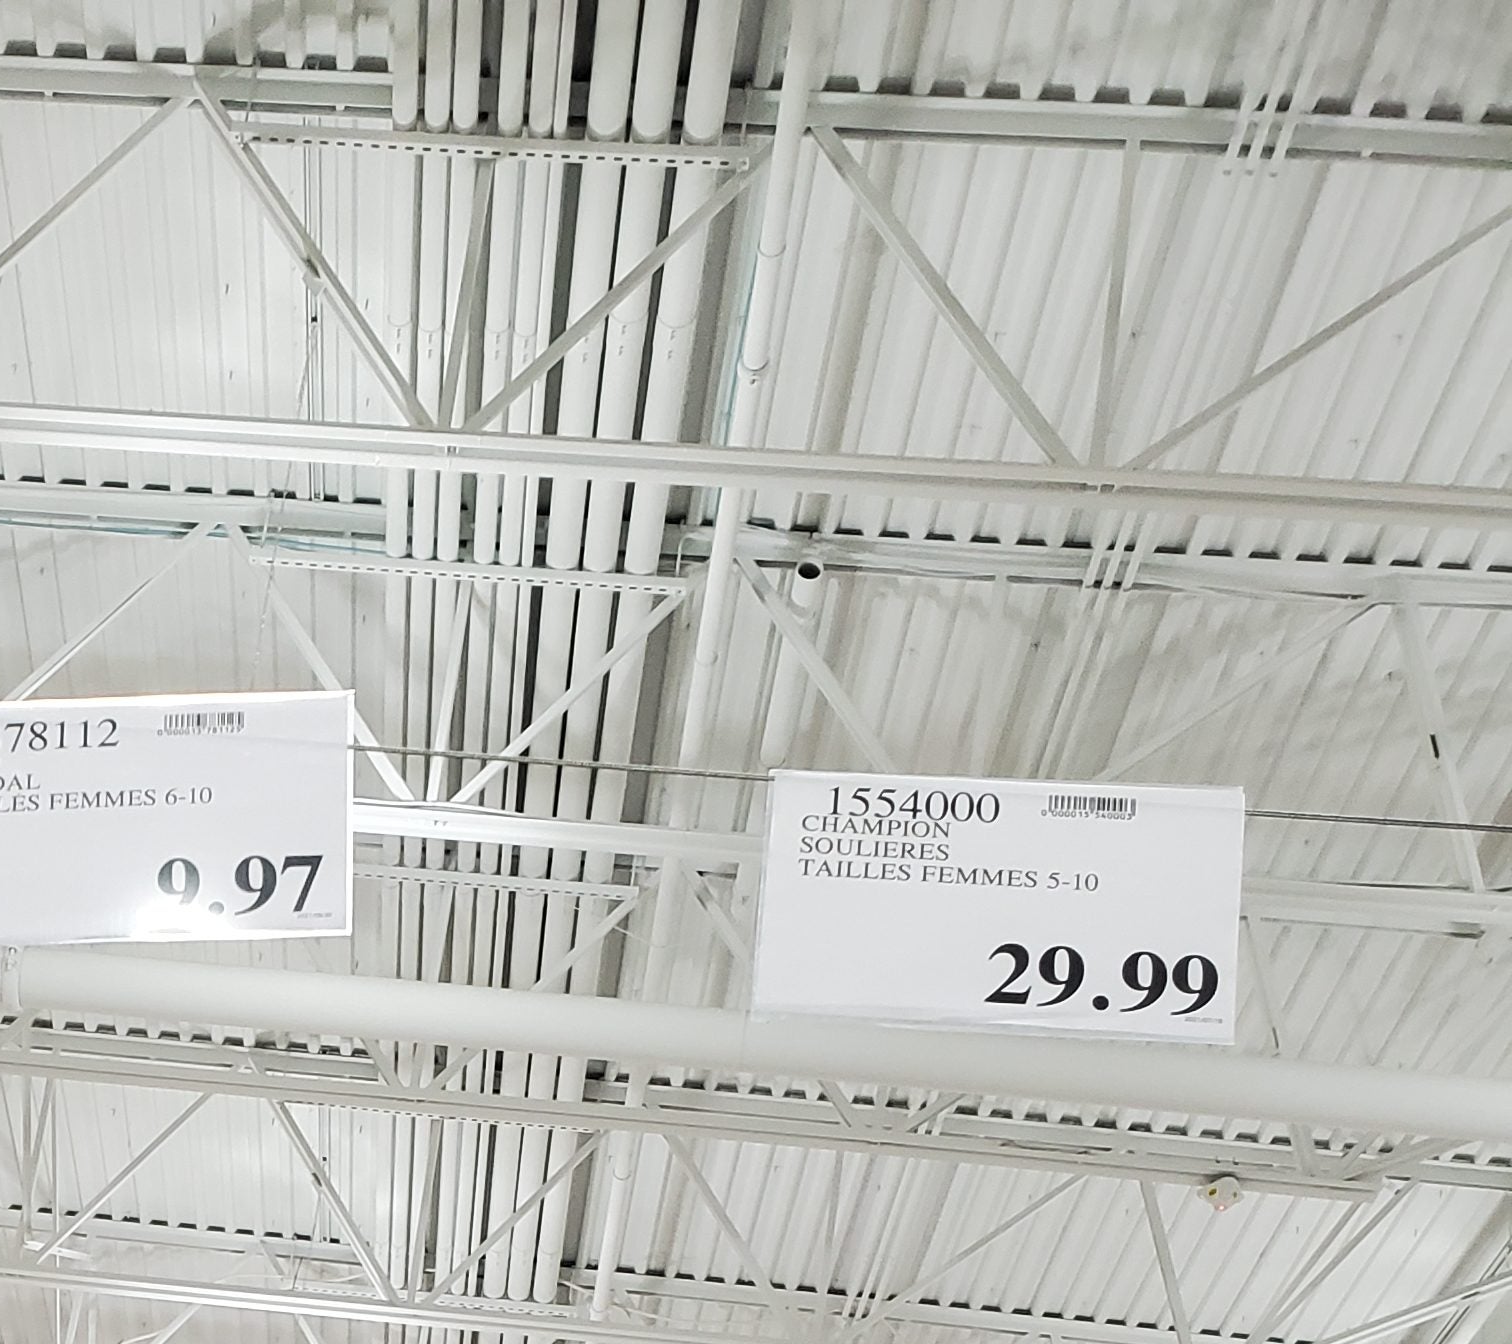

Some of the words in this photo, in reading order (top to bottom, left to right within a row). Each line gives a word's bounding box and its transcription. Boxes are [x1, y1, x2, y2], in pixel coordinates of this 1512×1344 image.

[49, 789, 157, 810] FEMMES
[164, 786, 213, 805] 6-10
[828, 786, 1001, 824] 1554000
[801, 814, 951, 839] CHAMPION
[799, 836, 950, 861] SOULIERES
[156, 854, 324, 917] 9.97
[797, 858, 912, 883] TAILLES
[921, 866, 1038, 890] FEMMES
[1046, 872, 1099, 892] 5-10
[983, 942, 1219, 1017] 29.99
